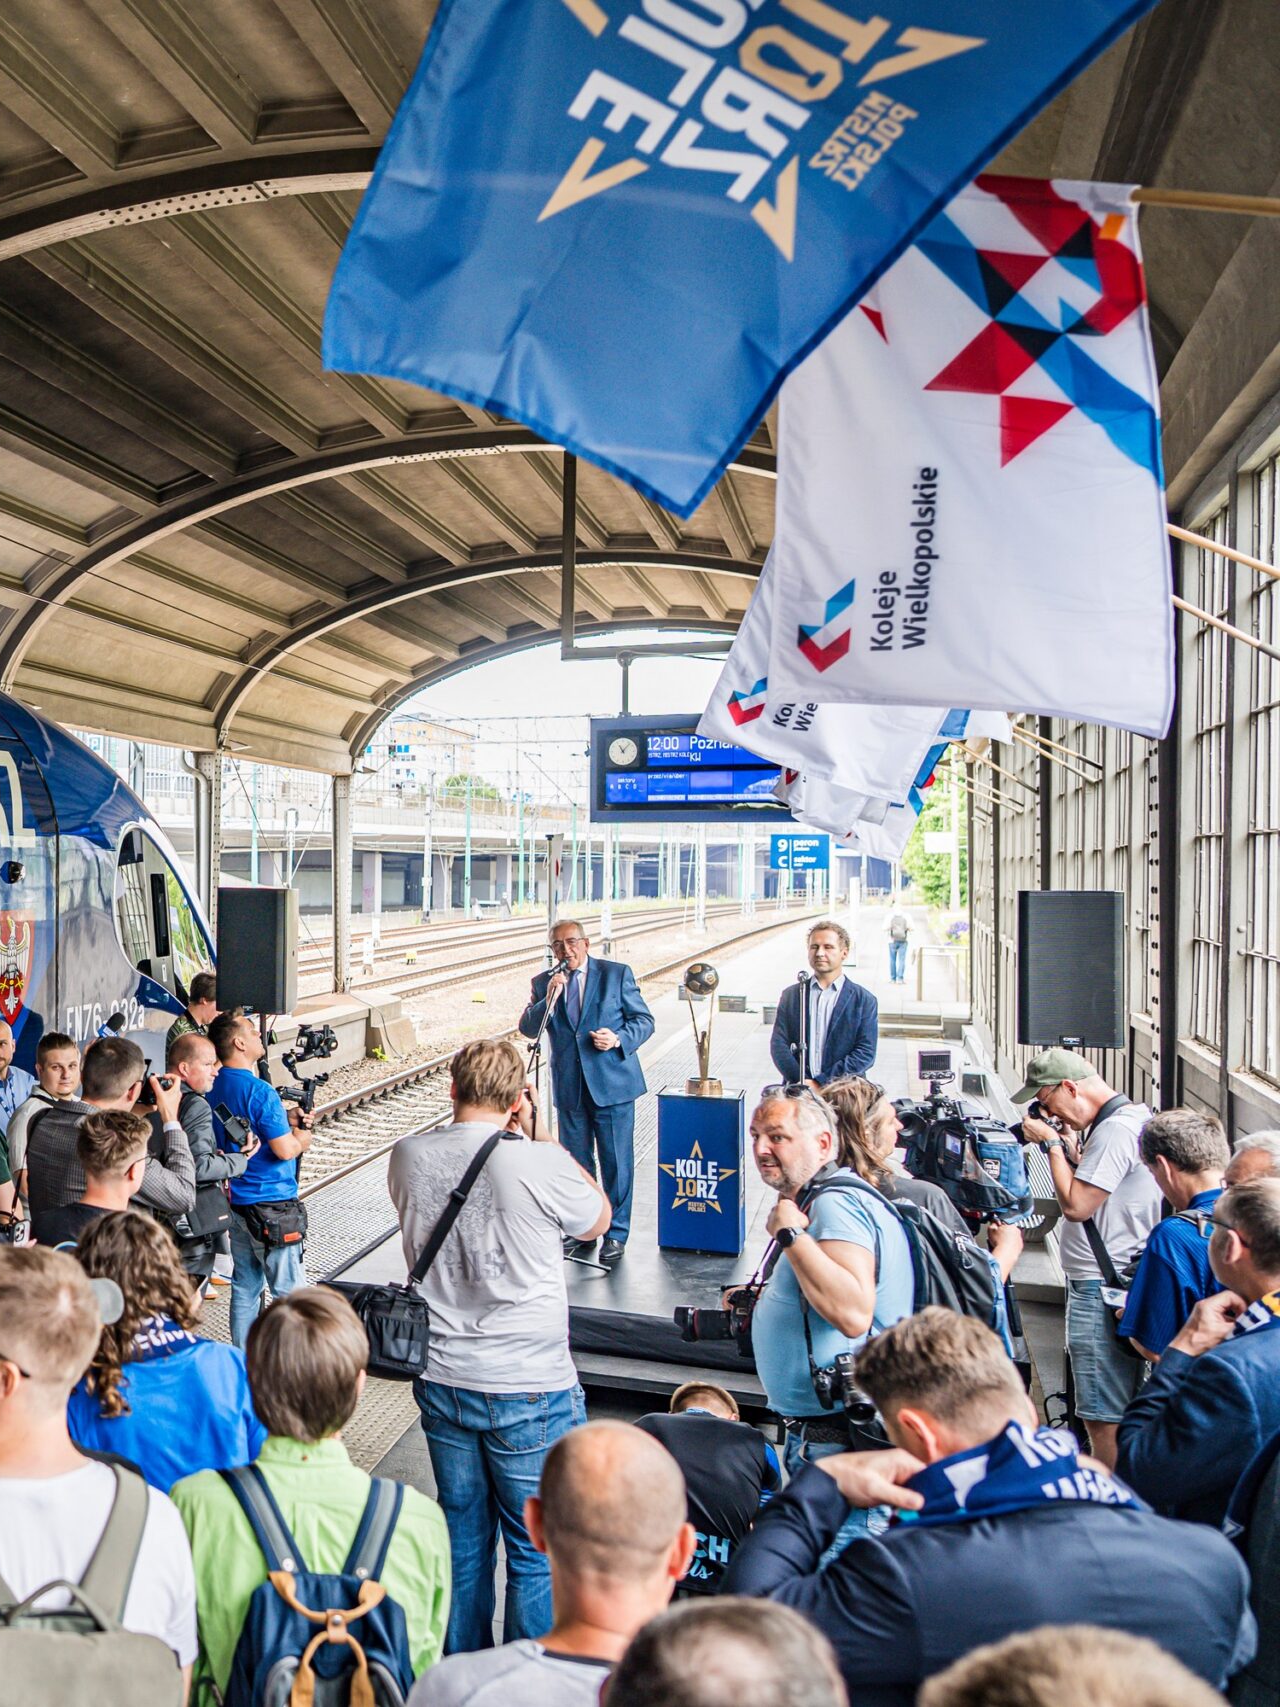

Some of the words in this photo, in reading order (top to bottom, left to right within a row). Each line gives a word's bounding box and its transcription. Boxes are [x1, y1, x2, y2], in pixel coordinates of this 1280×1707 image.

[902, 467, 940, 650] Wielkopolskie
[870, 571, 902, 651] Koleje
[647, 737, 680, 751] 12:00
[777, 838, 789, 853] 9
[777, 855, 788, 868] C
[675, 1158, 718, 1180] KOLE
[676, 1177, 718, 1200] 10RZ
